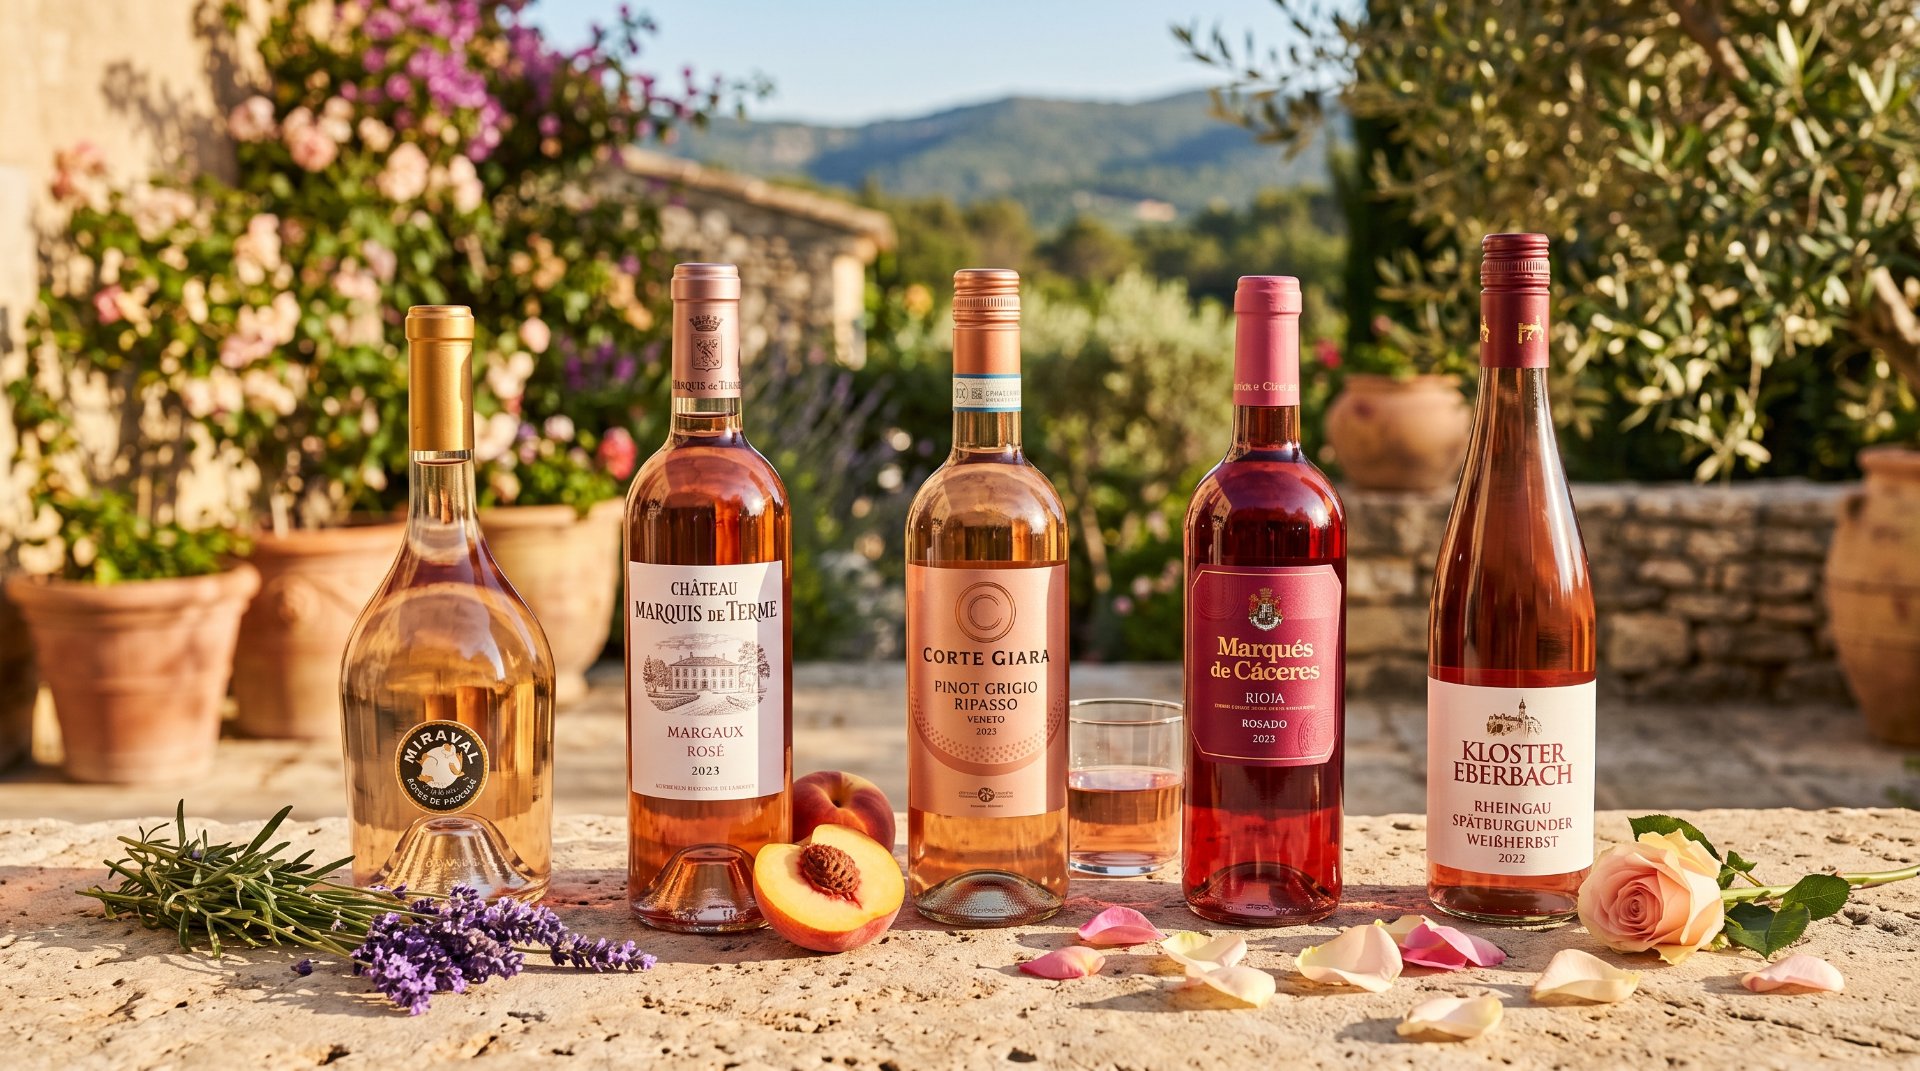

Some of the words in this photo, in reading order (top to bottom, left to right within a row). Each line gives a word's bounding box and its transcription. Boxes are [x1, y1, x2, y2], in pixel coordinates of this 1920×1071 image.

[671, 579, 738, 596] CHÂTEAU
[635, 601, 702, 624] MARQUIS
[708, 610, 726, 622] DE
[726, 600, 777, 622] TERME
[923, 647, 984, 666] CORTE
[991, 649, 1050, 666] GIARA
[1217, 636, 1314, 663] Marqués
[1210, 661, 1231, 679] de
[1234, 660, 1320, 681] Cáceres
[935, 680, 979, 694] PINOT
[985, 681, 1038, 695] GRIGIO
[954, 698, 1018, 711] RIPASSO
[1245, 693, 1285, 704] RIOJA
[967, 715, 1005, 723] VENETO
[1242, 719, 1287, 729] ROSADO
[667, 726, 744, 739] MARGAUX
[976, 728, 997, 736] 2023
[1252, 734, 1276, 743] 2023
[404, 730, 479, 764] MIRAVAL
[687, 744, 725, 757] ROSÉ
[1462, 740, 1566, 764] KLOSTER
[691, 766, 720, 776] 2023
[1454, 761, 1573, 787] EBERBACH
[1474, 800, 1551, 814] RHEINGAU
[1452, 813, 1573, 832] SPÄTBURGUNDER
[1467, 833, 1559, 849] WEIßHERBST
[1498, 853, 1526, 864] 2022
